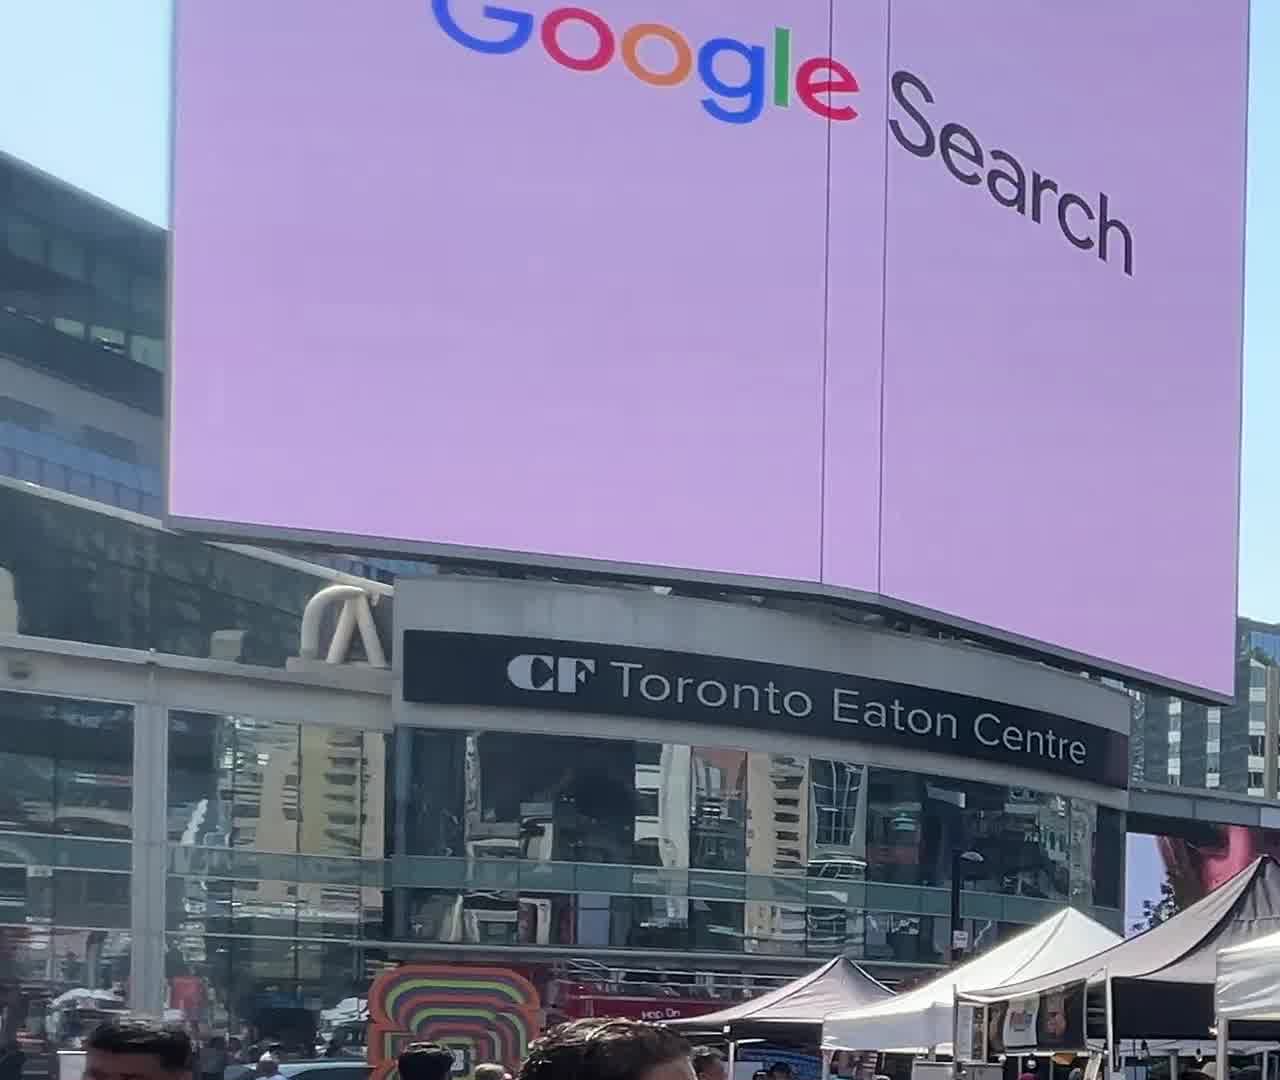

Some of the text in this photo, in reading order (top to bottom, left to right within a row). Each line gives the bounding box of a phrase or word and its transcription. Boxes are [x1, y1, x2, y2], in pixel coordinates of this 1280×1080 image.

[888, 70, 1136, 276] Search
[506, 653, 1088, 767] CF Toronto Eaton Centre
